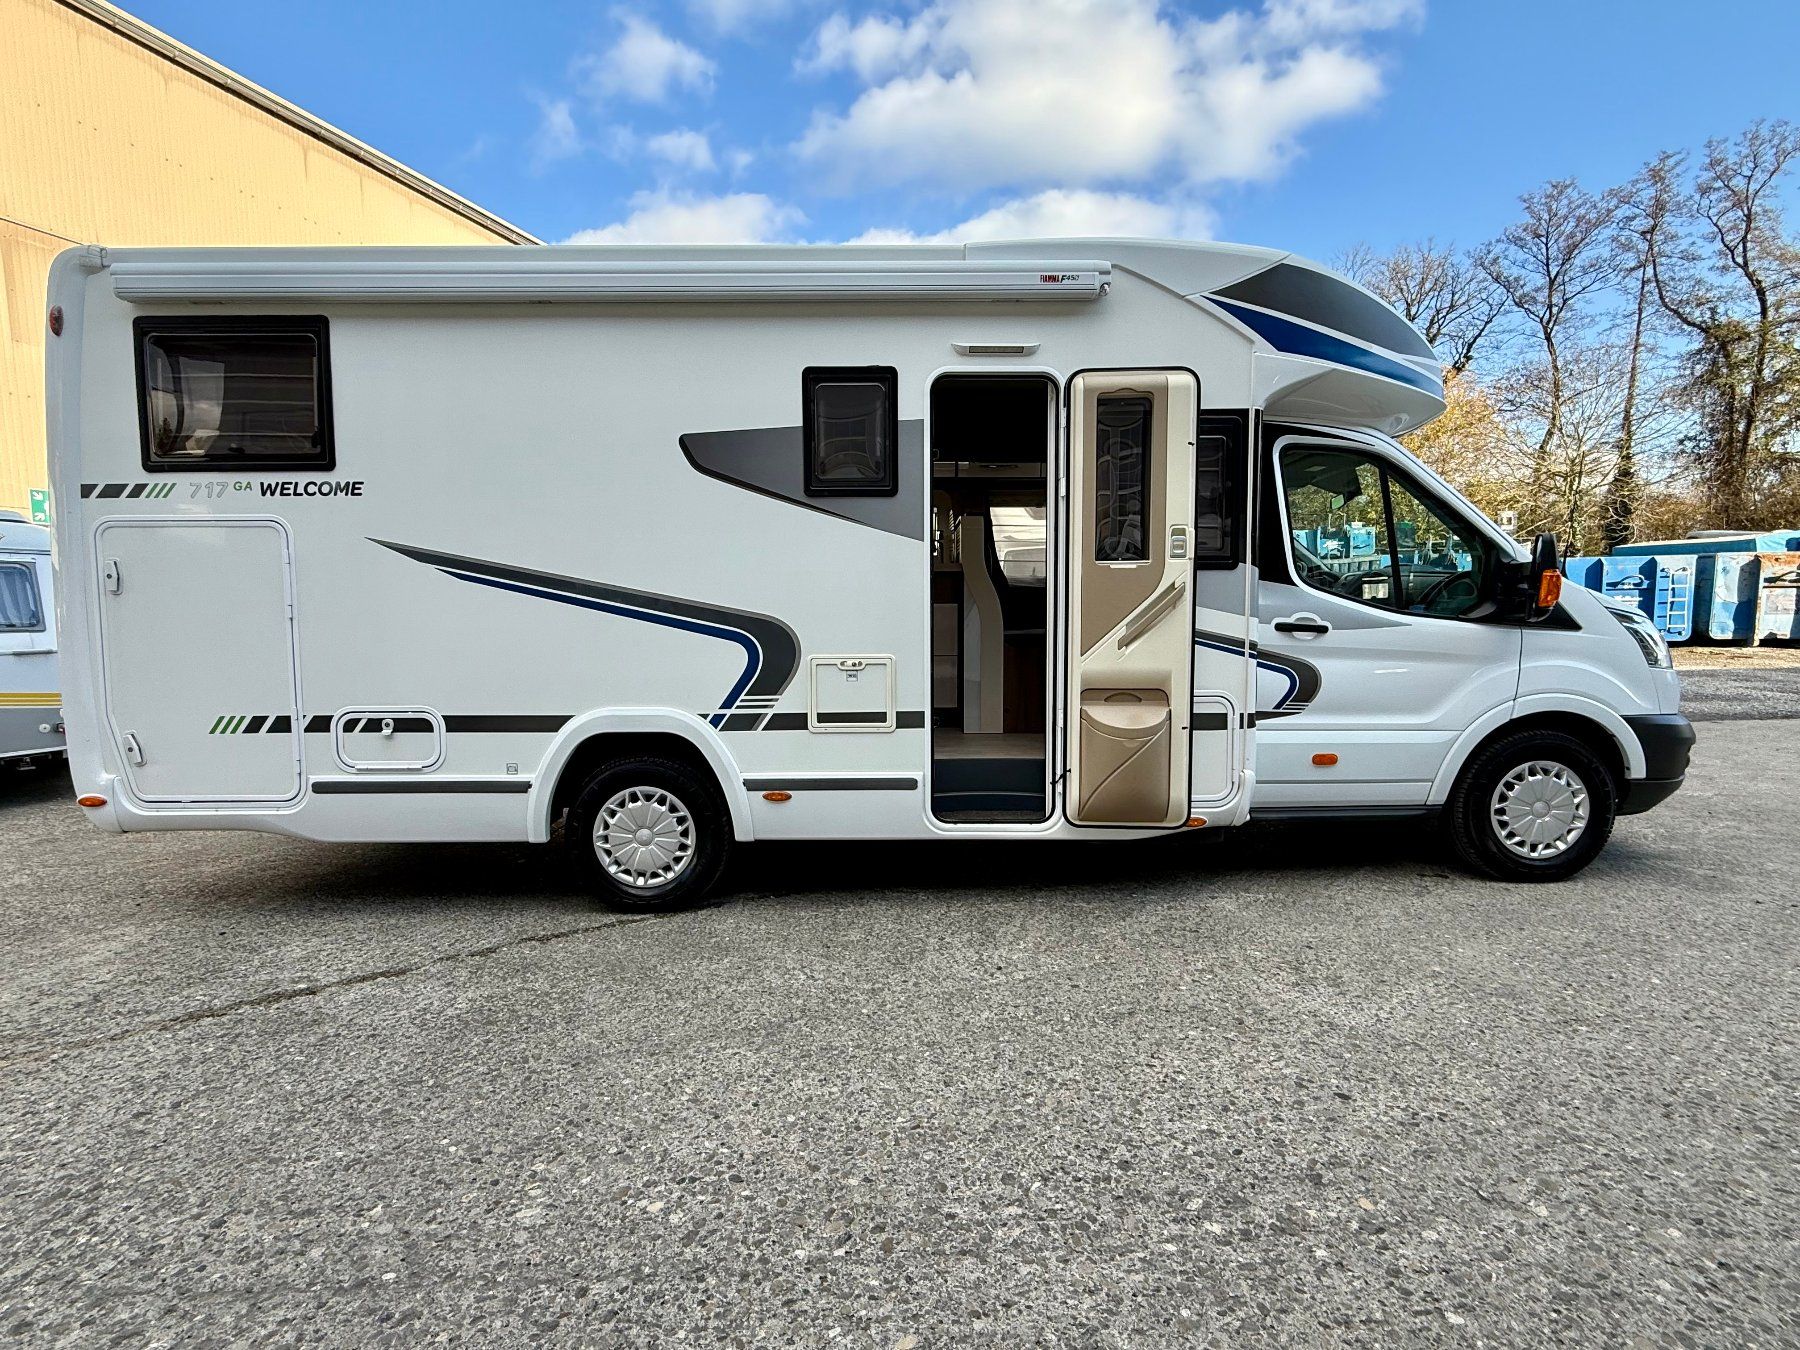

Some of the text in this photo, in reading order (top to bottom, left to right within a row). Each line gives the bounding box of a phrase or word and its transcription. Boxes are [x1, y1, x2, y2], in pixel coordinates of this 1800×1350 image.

[189, 480, 365, 499] 717 GA WELCOME
